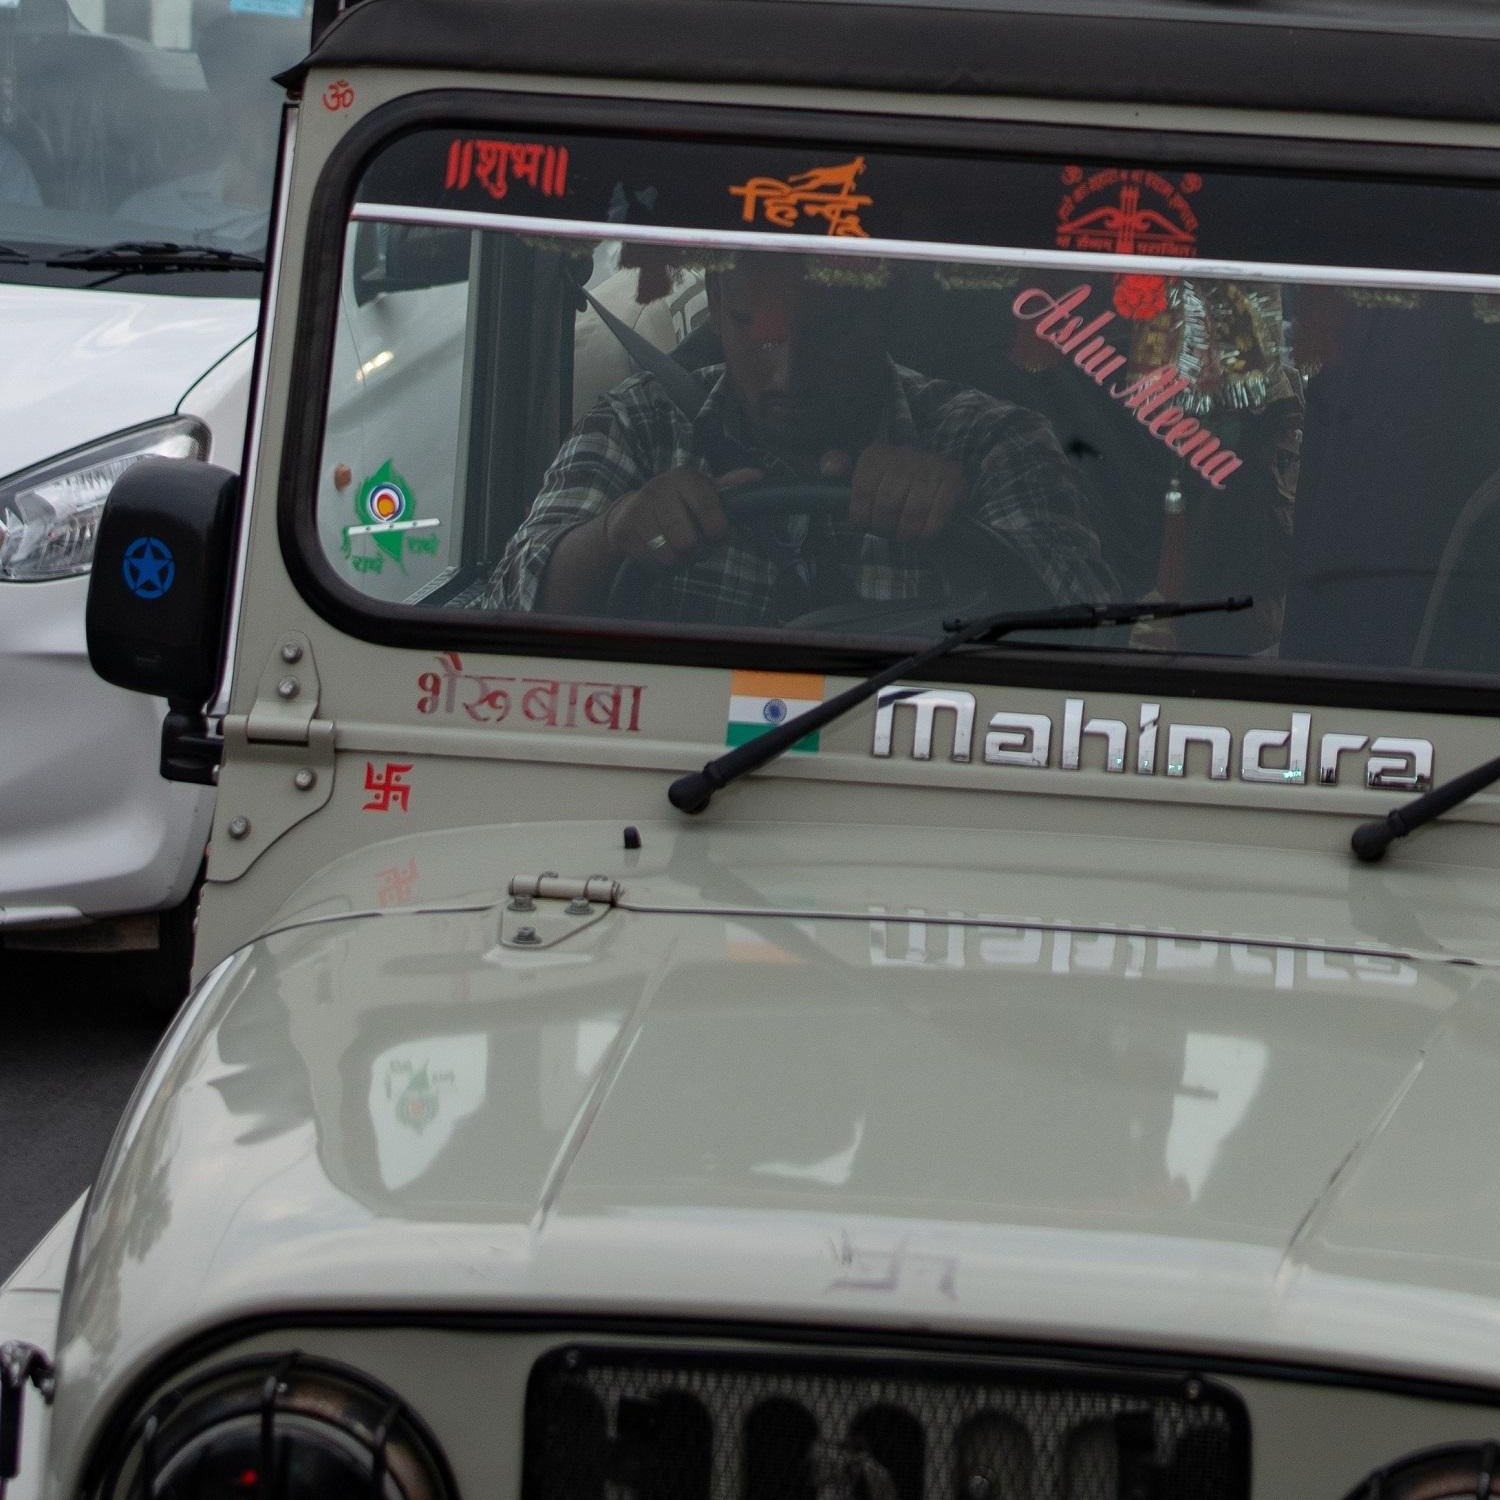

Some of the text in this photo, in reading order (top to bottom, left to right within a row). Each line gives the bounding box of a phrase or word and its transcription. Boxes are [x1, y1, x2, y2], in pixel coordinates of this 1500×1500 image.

[1013, 283, 1243, 490] Ashu Meena
[873, 684, 1435, 790] Mahindra
